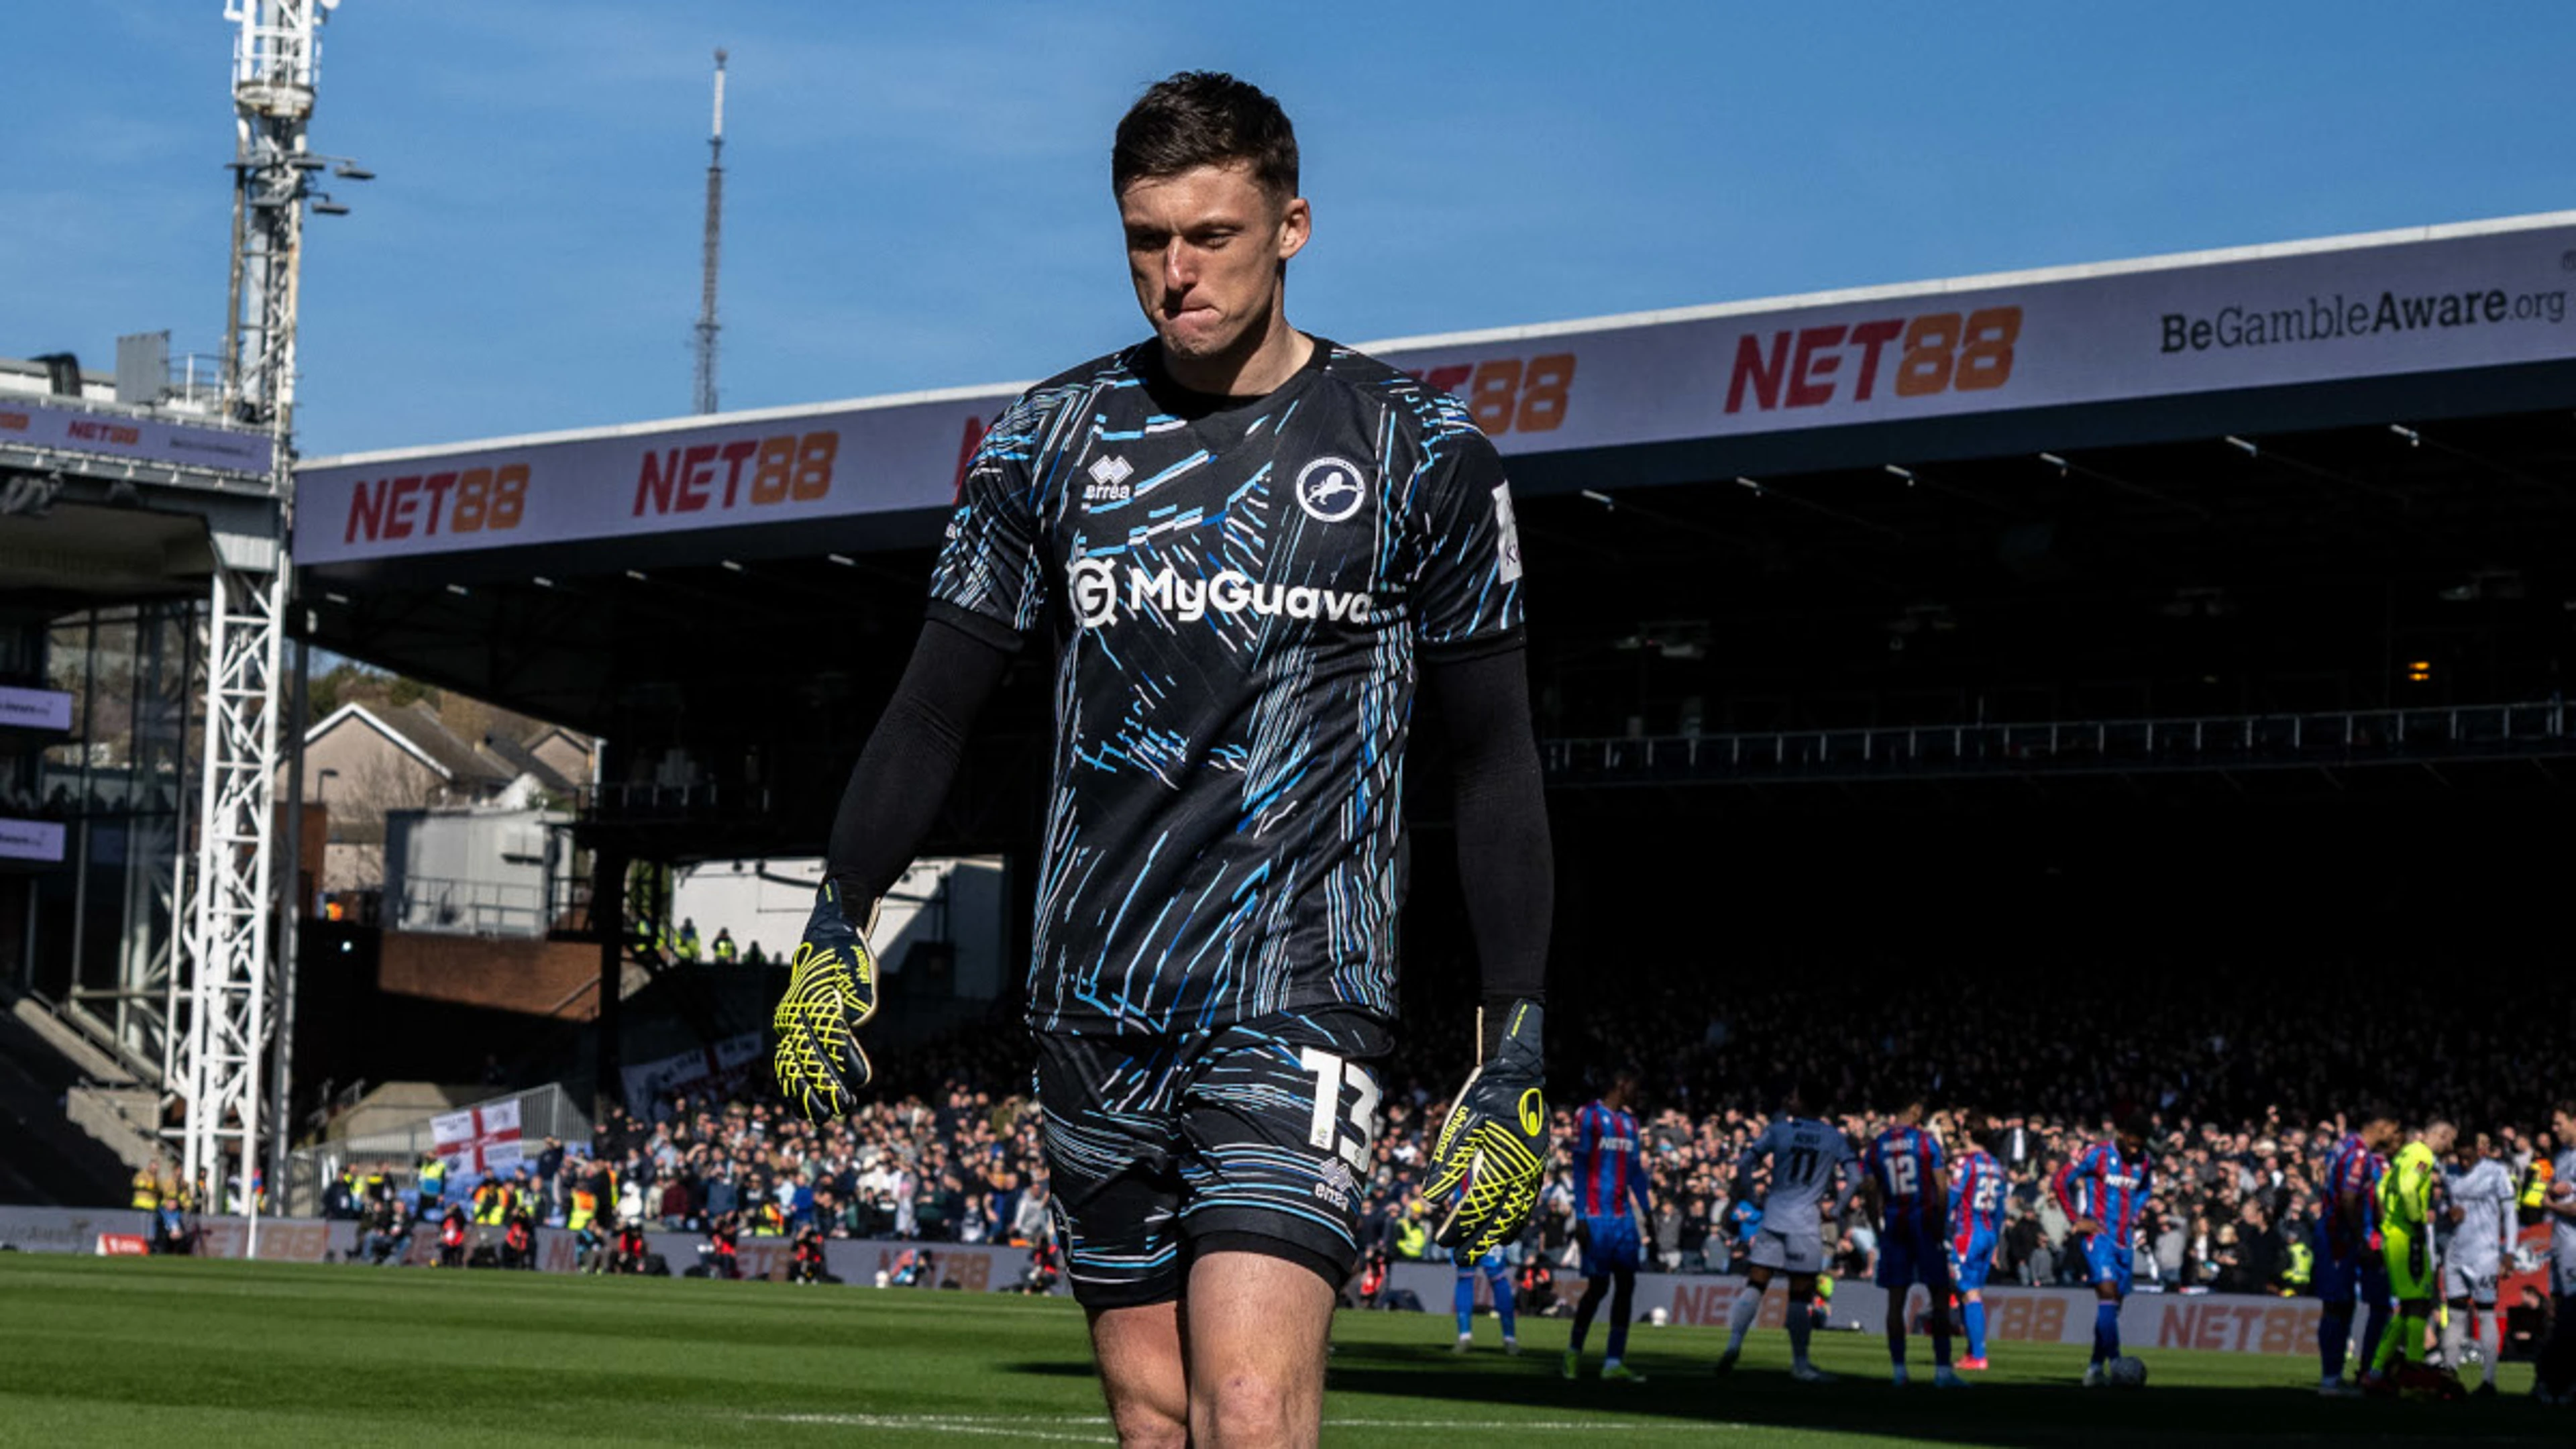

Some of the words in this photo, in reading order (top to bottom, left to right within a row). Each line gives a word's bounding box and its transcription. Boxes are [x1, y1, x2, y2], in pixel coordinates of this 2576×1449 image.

[1723, 306, 2023, 414] NET88
[2160, 288, 2567, 354] BeGambleAware.org
[1407, 353, 1576, 435] T88
[344, 464, 531, 544] NET88
[632, 431, 839, 517] NET88
[1131, 568, 1370, 625] MyGuava
[1301, 1046, 1378, 1173] 13
[1884, 1155, 1919, 1195] 12
